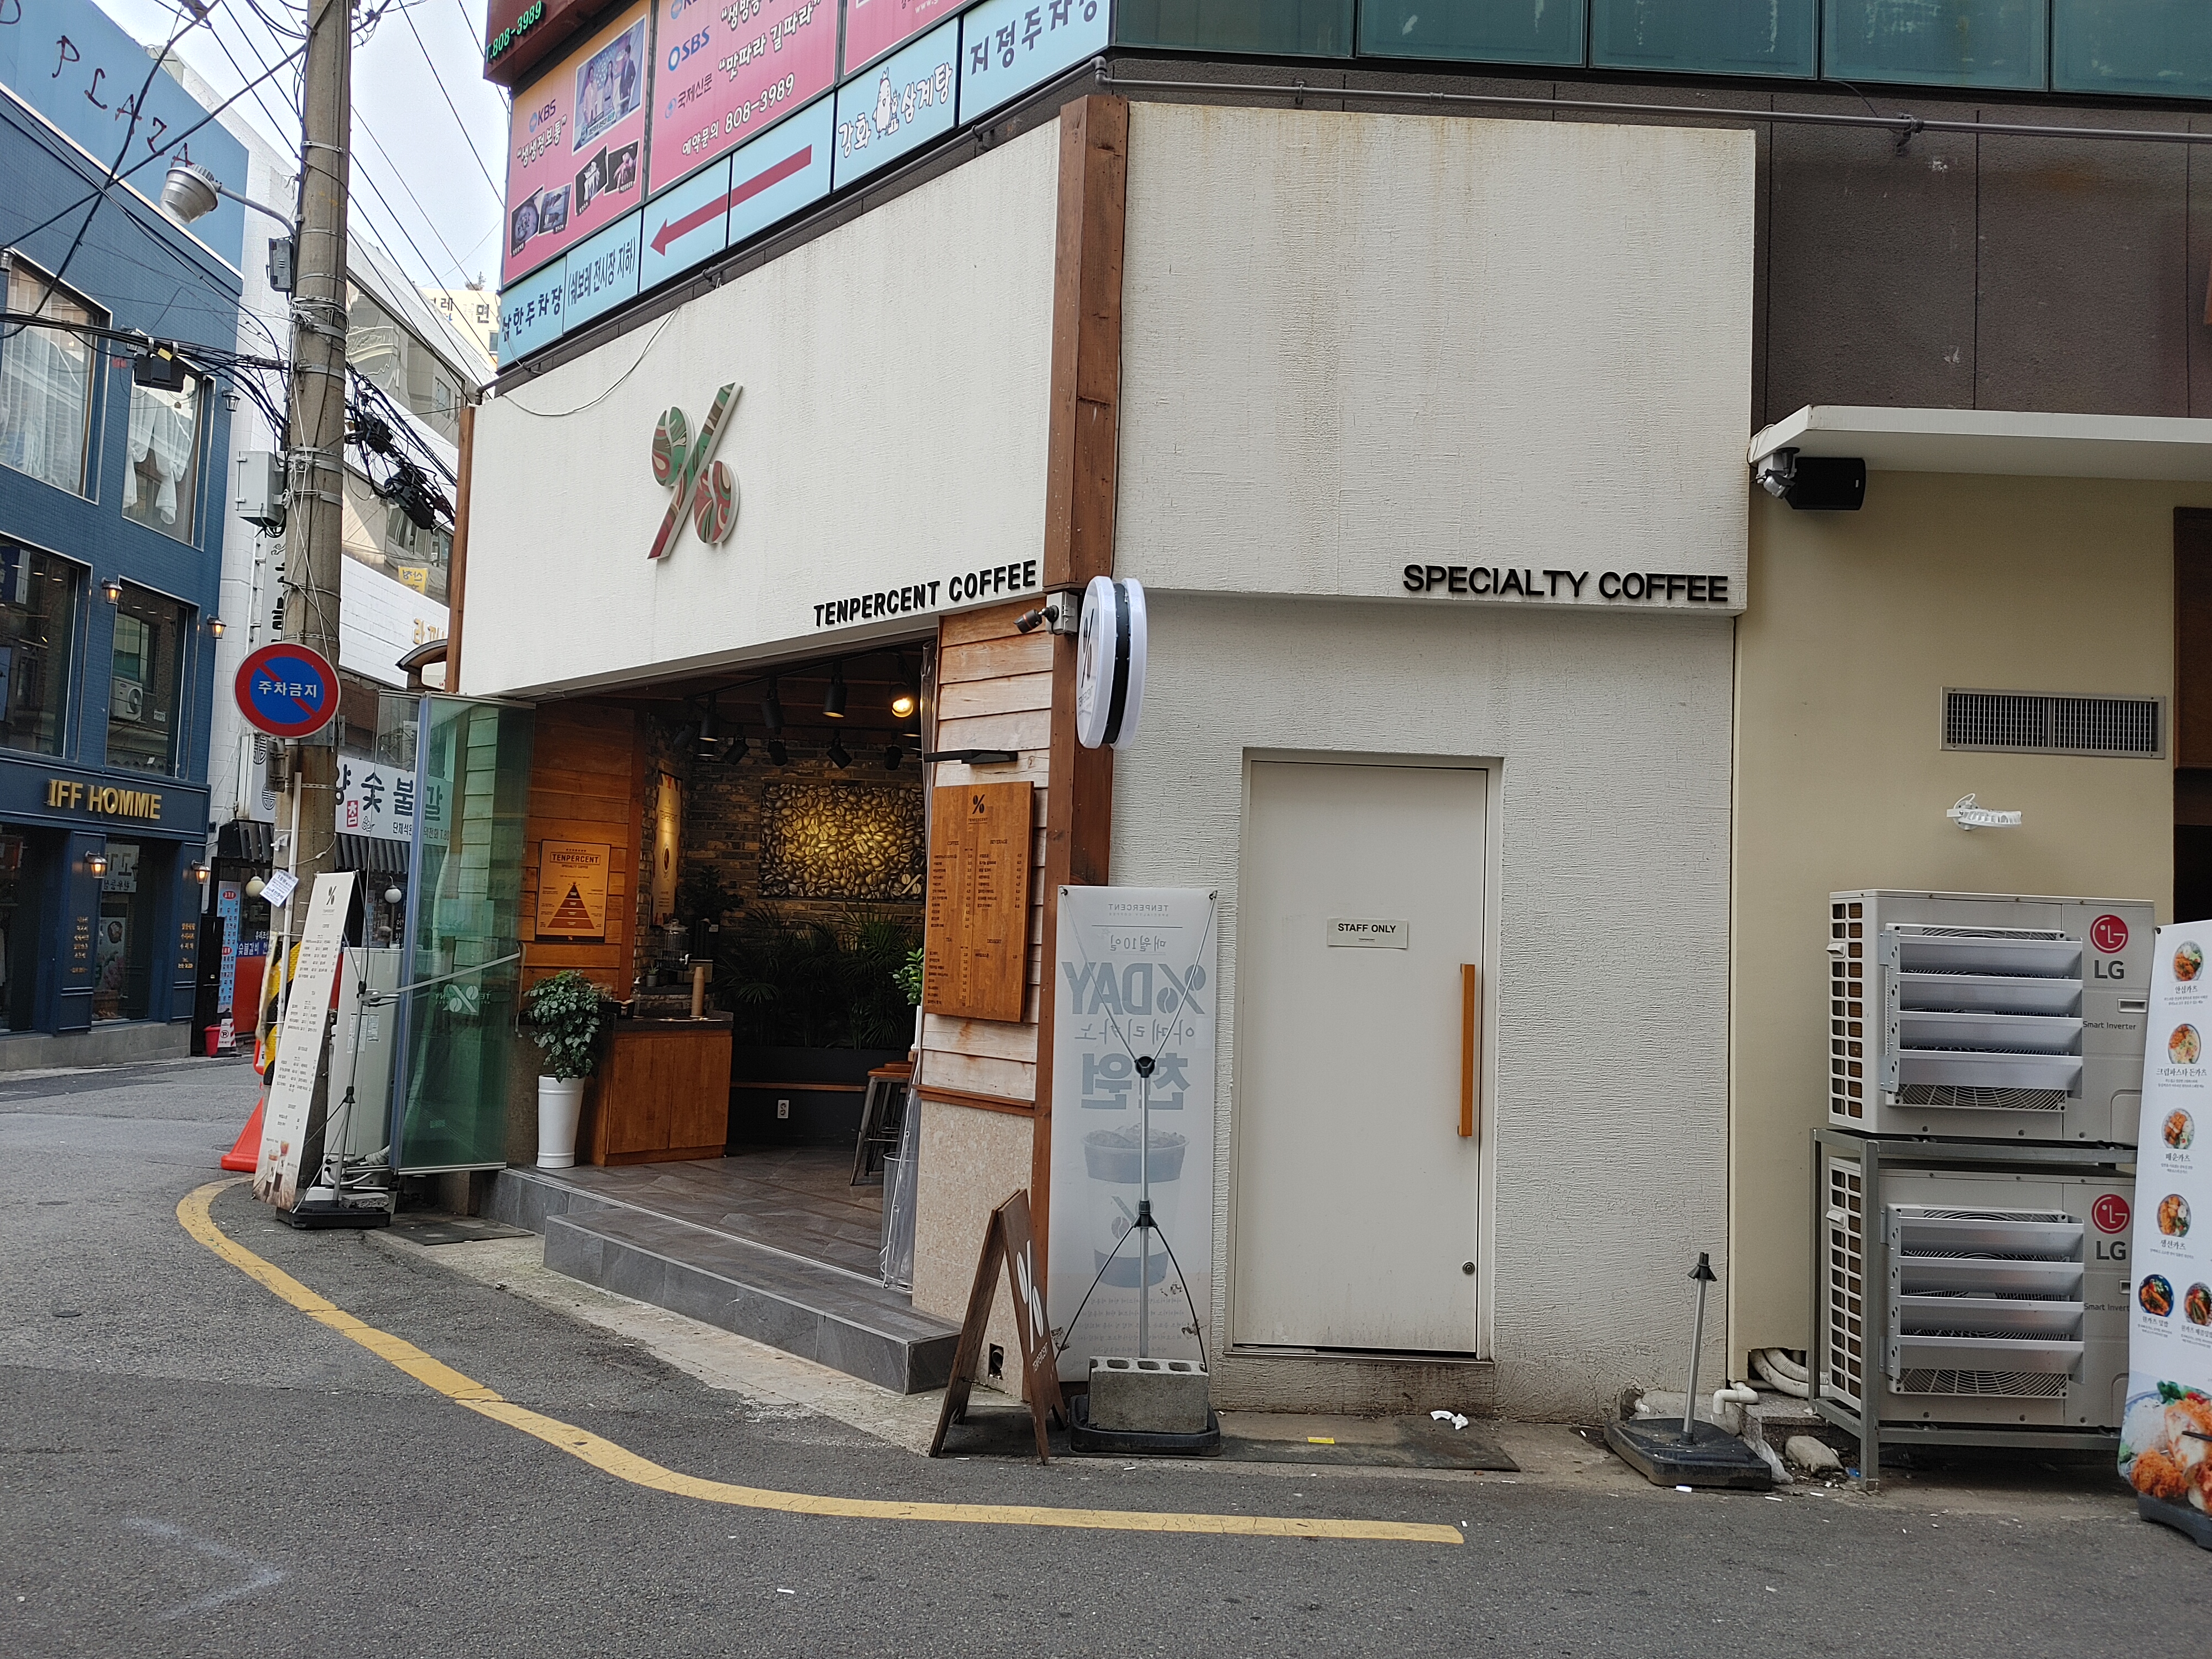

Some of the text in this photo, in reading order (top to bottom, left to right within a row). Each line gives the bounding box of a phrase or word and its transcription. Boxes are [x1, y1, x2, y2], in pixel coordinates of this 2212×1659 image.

[485, 0, 542, 63] T.808-3989
[681, 25, 710, 62] SBS
[677, 72, 713, 109] 국제신문
[537, 98, 556, 127] KBS
[681, 72, 795, 156] 예약문의 808-3989
[838, 61, 953, 159] 강화 삼계탕
[593, 248, 616, 293] 전시장
[813, 559, 1036, 627] TENPERCENT COFFEE
[1402, 564, 1728, 602] SPECIALTY COFFEE
[258, 680, 317, 698] 주차금지
[48, 779, 162, 820] IFF HOMME
[552, 854, 599, 863] TENPERCENT
[1338, 923, 1396, 933] STAFF ONLY
[2094, 960, 2125, 979] LG
[2174, 985, 2198, 994] 안심카츠
[2083, 1021, 2136, 1030] Smart Inverter
[2156, 1068, 2207, 1077] 크림파스타 돈카츠
[2165, 1152, 2190, 1162] 매운카츠
[2096, 1240, 2126, 1260] LG
[2160, 1239, 2186, 1250] 생선카츠
[2084, 1302, 2130, 1312] Smart Invert
